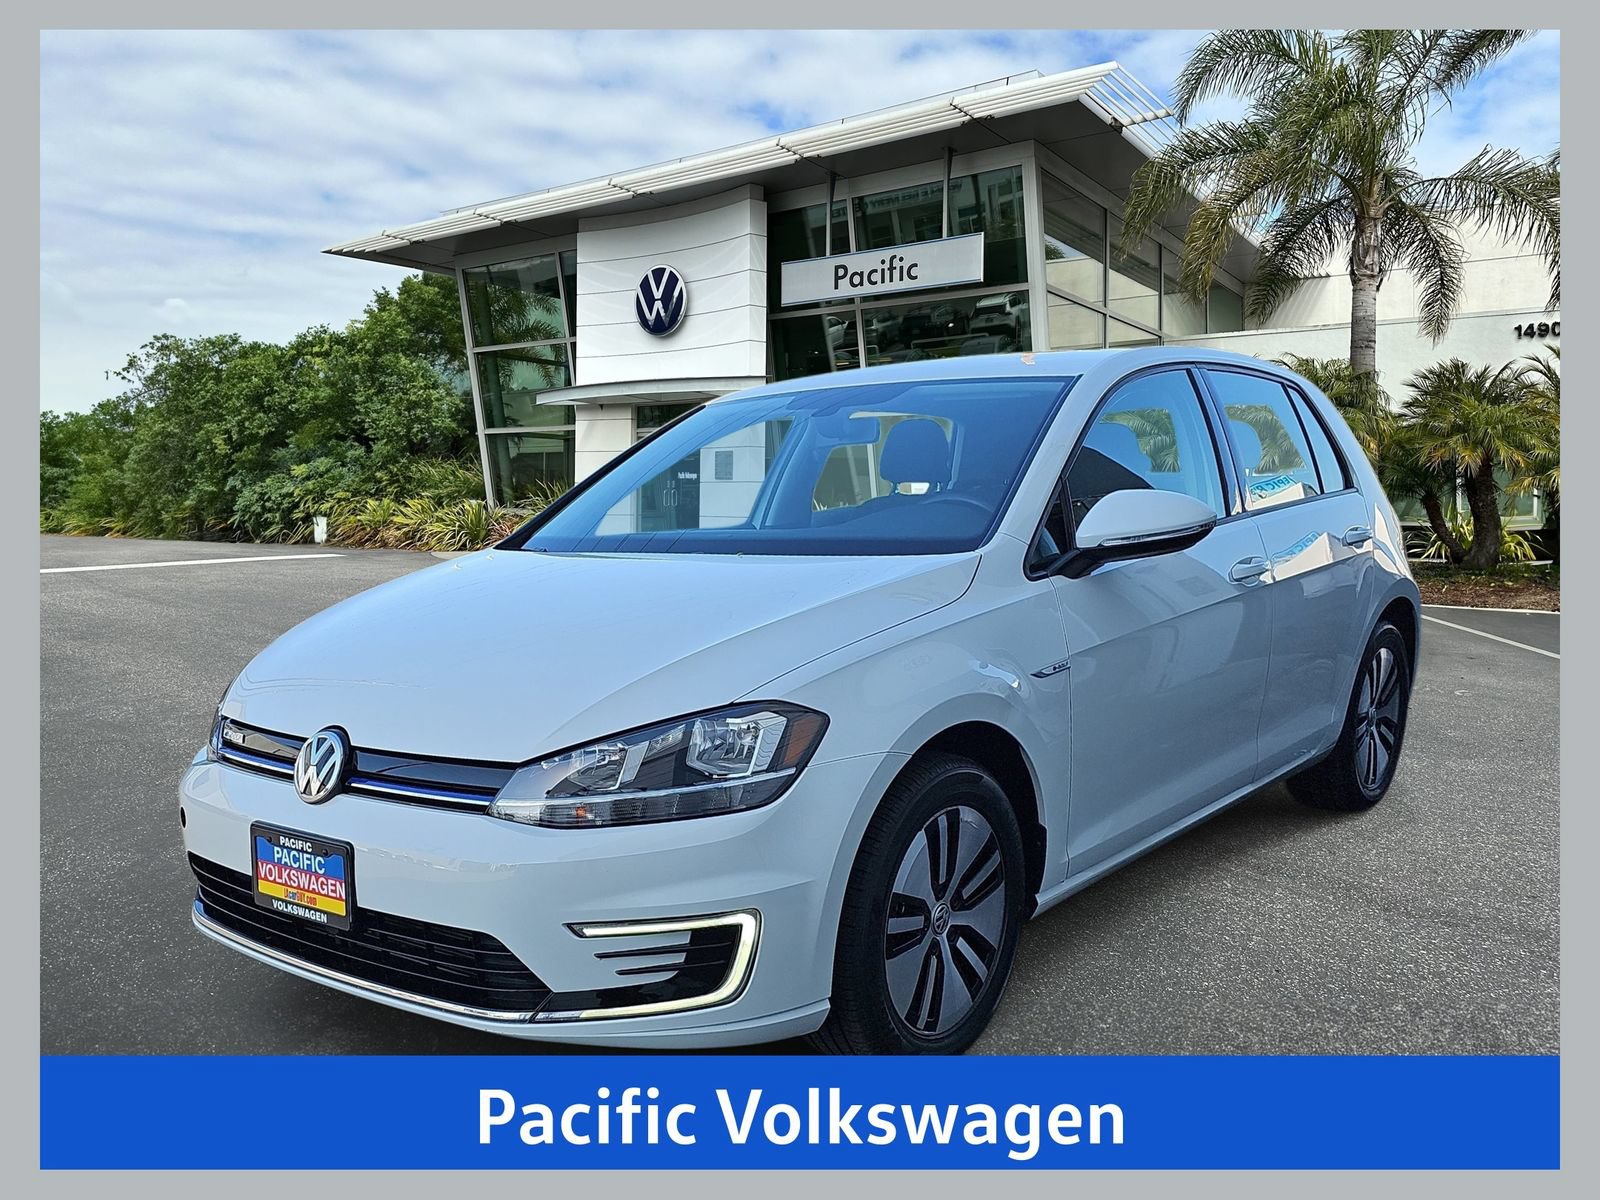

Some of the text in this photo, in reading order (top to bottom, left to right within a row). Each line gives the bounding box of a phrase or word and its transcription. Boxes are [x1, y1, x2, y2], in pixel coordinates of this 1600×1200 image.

[834, 255, 919, 290] Pacific
[280, 836, 312, 852] PACIFIC
[274, 846, 325, 874] PACIFIC
[258, 861, 345, 899] VOLKSWAGEN
[272, 899, 327, 923] VOLKSWAGEN
